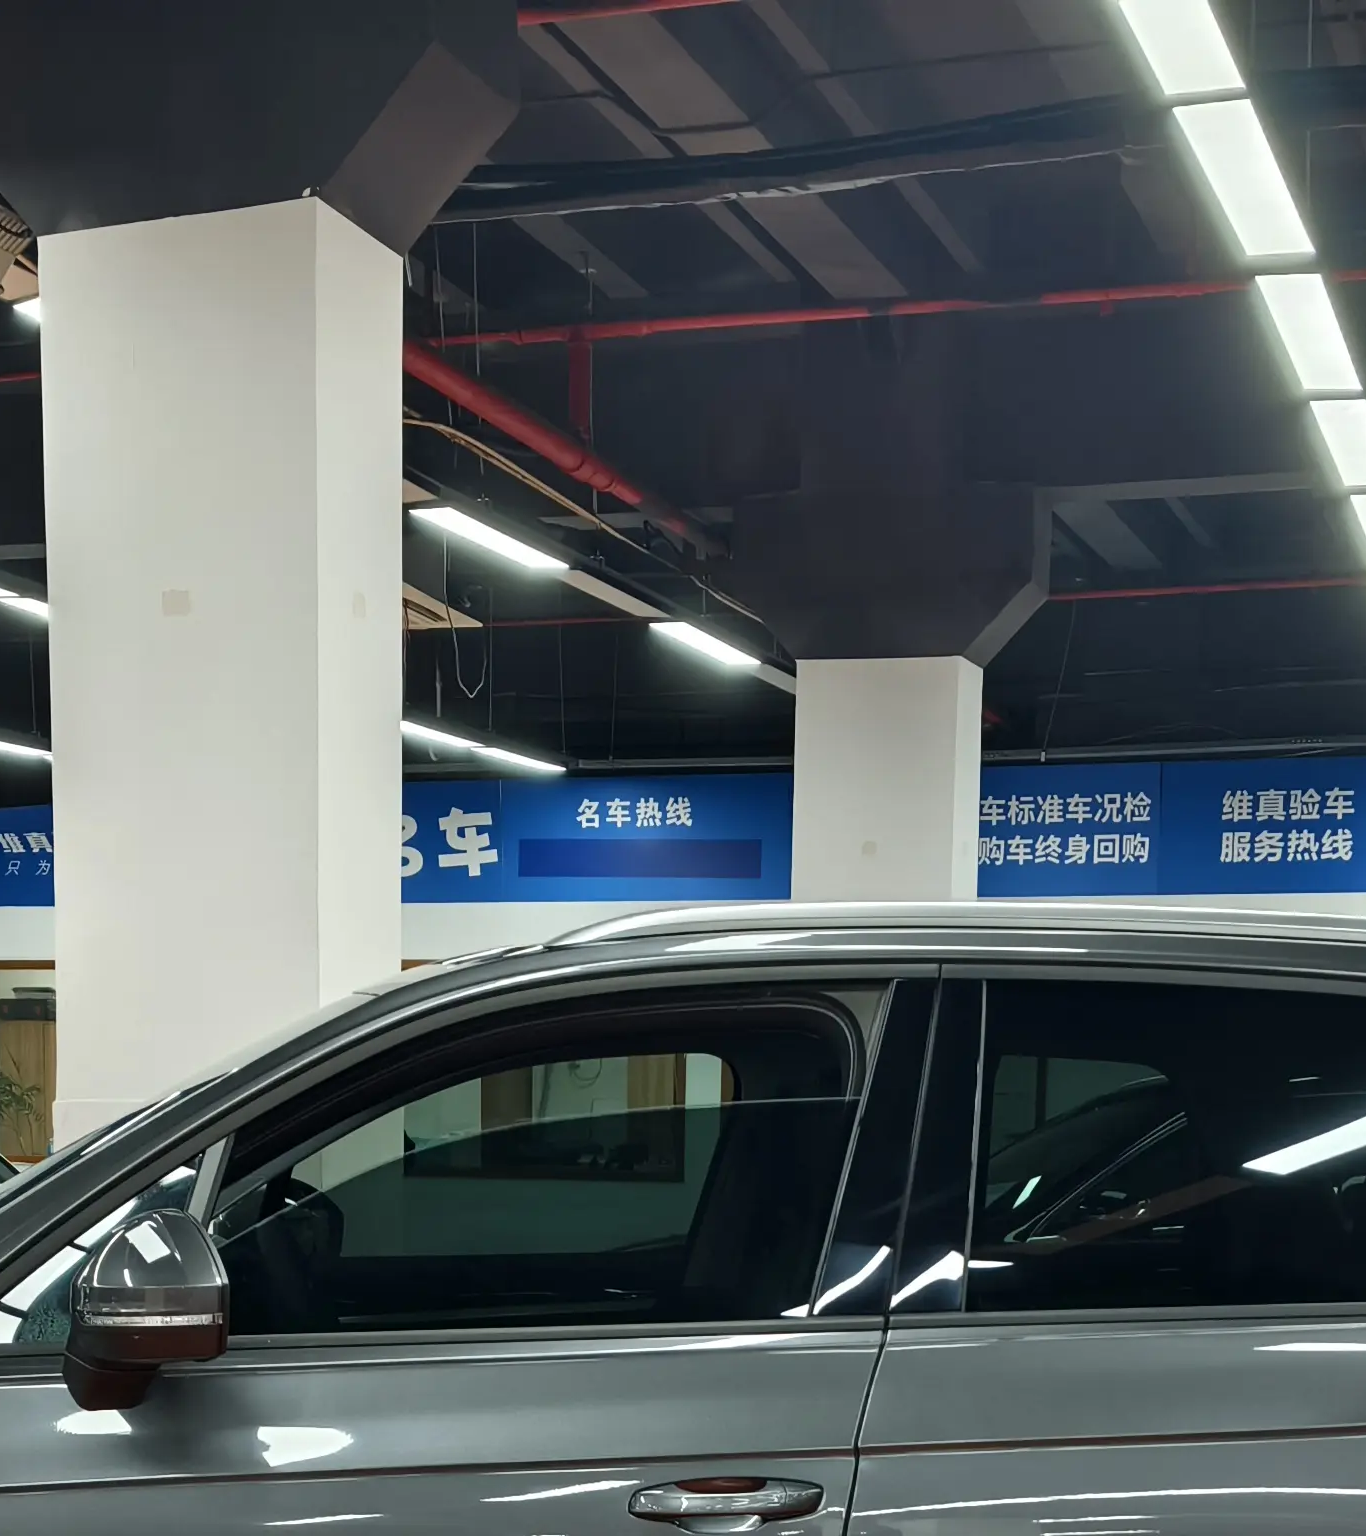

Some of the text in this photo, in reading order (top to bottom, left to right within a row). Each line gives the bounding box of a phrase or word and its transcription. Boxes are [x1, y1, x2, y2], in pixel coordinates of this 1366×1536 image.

[576, 797, 693, 829] 名车热线
[979, 791, 1152, 826] 车标准车况检
[1221, 787, 1355, 822] 维真验车
[978, 832, 1150, 866] 购车终身回购
[1220, 829, 1354, 863] 服务热线
